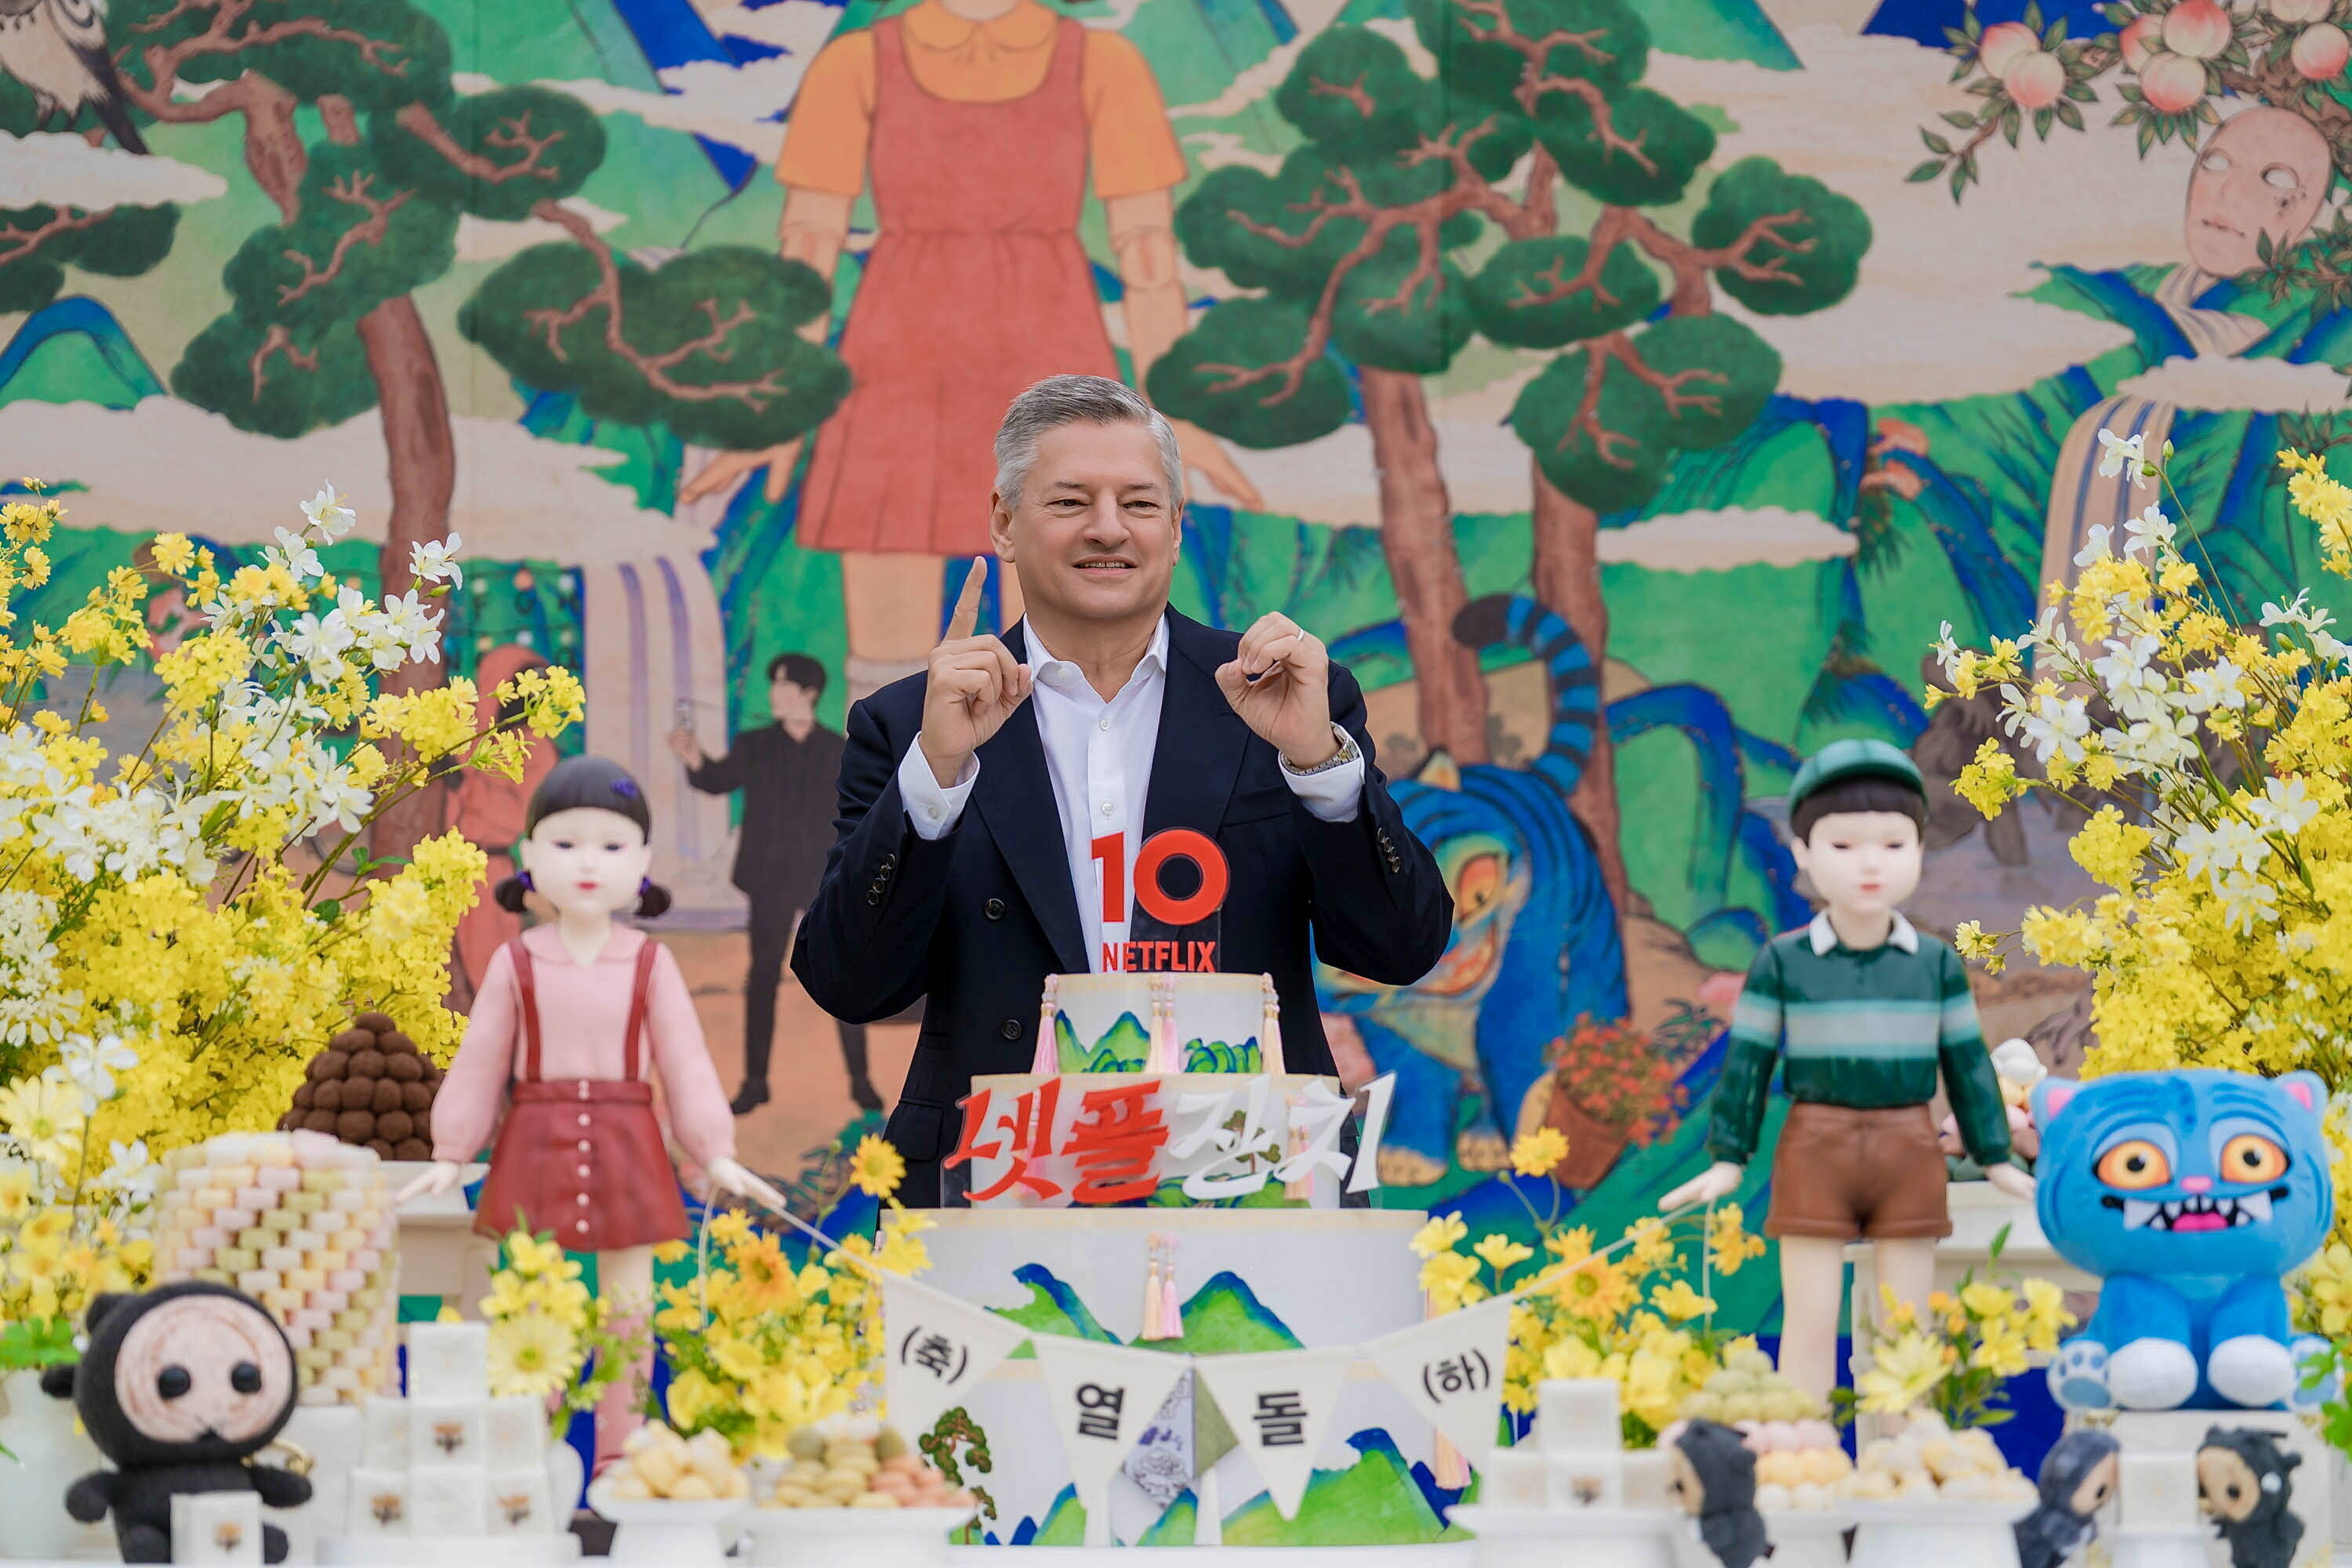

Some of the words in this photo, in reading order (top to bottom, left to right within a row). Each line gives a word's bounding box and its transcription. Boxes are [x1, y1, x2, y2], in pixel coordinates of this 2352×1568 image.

[1091, 829, 1228, 926] 10
[1102, 941, 1217, 973] NETFLIX
[1076, 1385, 1124, 1440] 열
[1253, 1392, 1307, 1446] 돌
